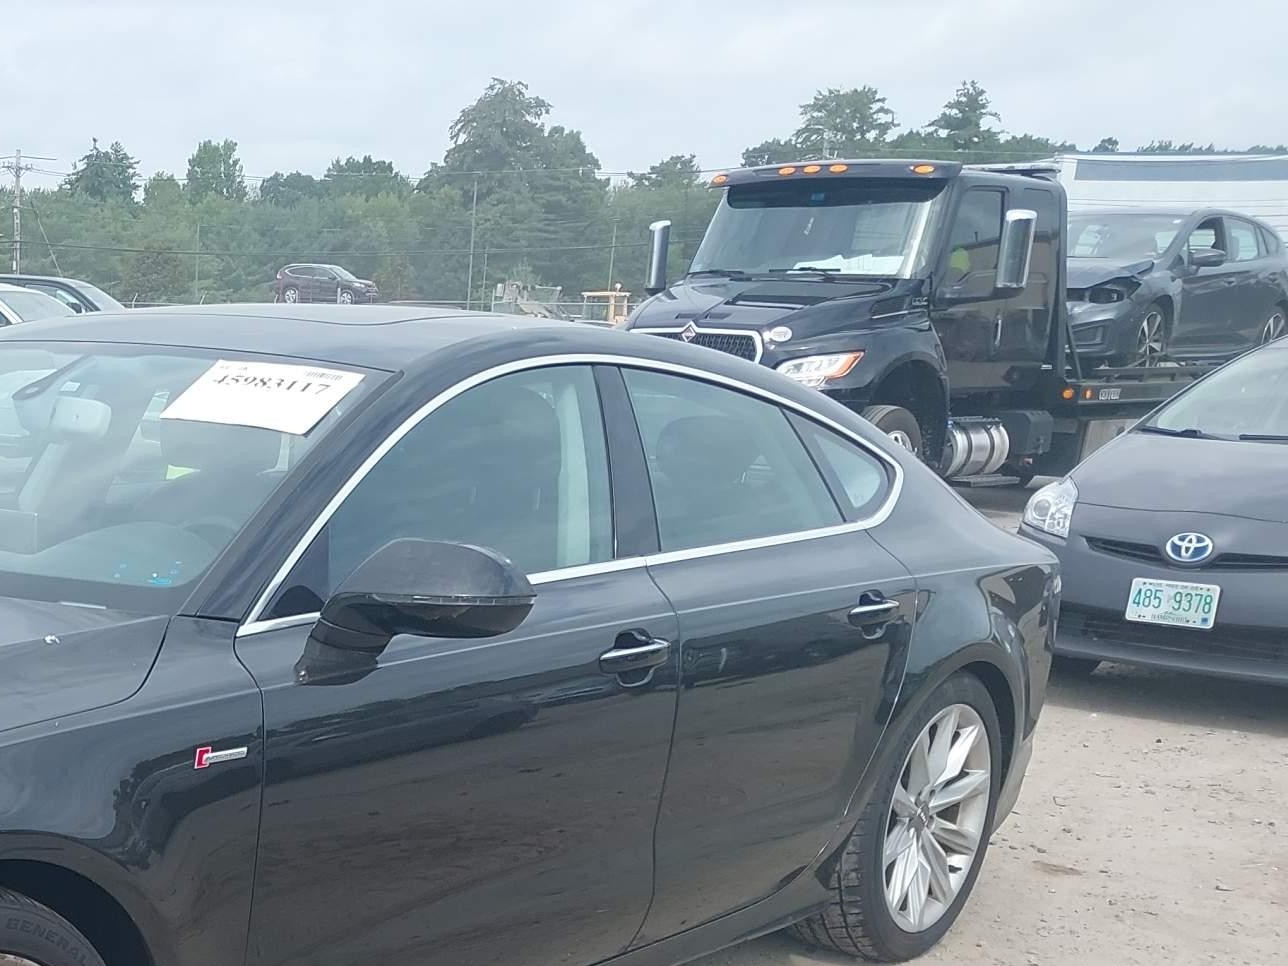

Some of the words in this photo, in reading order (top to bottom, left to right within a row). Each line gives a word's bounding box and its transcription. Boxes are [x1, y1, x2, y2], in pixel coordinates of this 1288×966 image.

[213, 374, 331, 395] 45983117
[1132, 588, 1163, 609] 485
[1172, 591, 1214, 615] 9378
